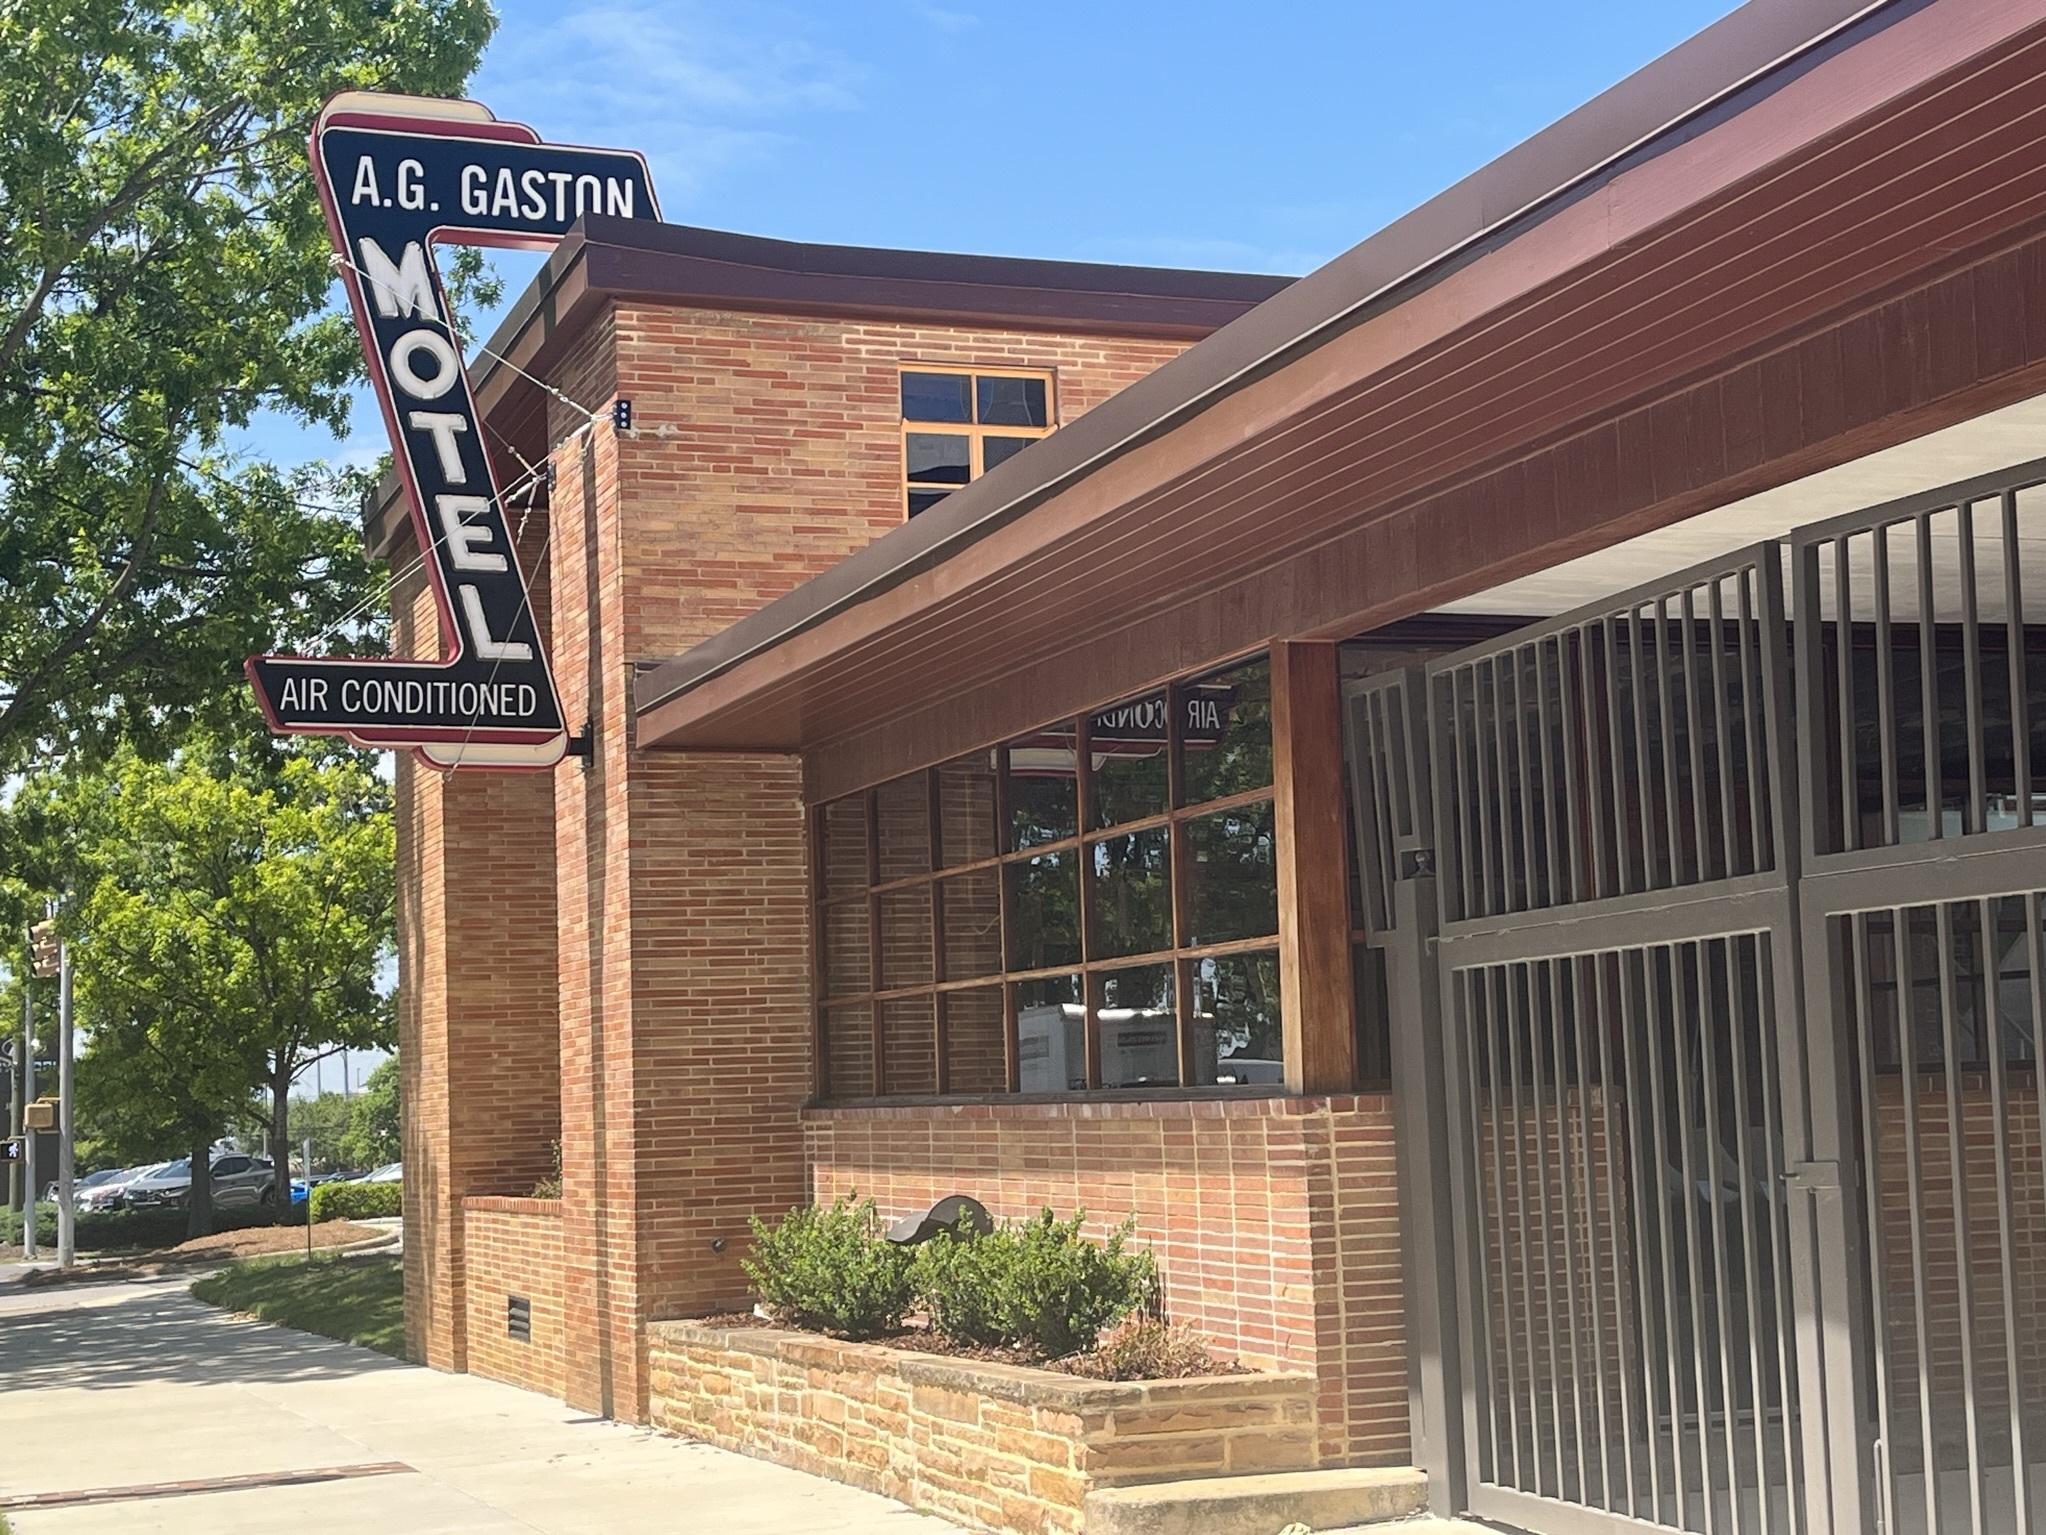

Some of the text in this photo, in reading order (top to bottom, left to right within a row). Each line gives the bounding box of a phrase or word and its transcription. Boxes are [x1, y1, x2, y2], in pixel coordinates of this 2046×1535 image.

[351, 155, 633, 221] A.G. GASTON
[358, 237, 533, 660] MOTEL
[280, 677, 537, 717] AIR CONDITIONED
